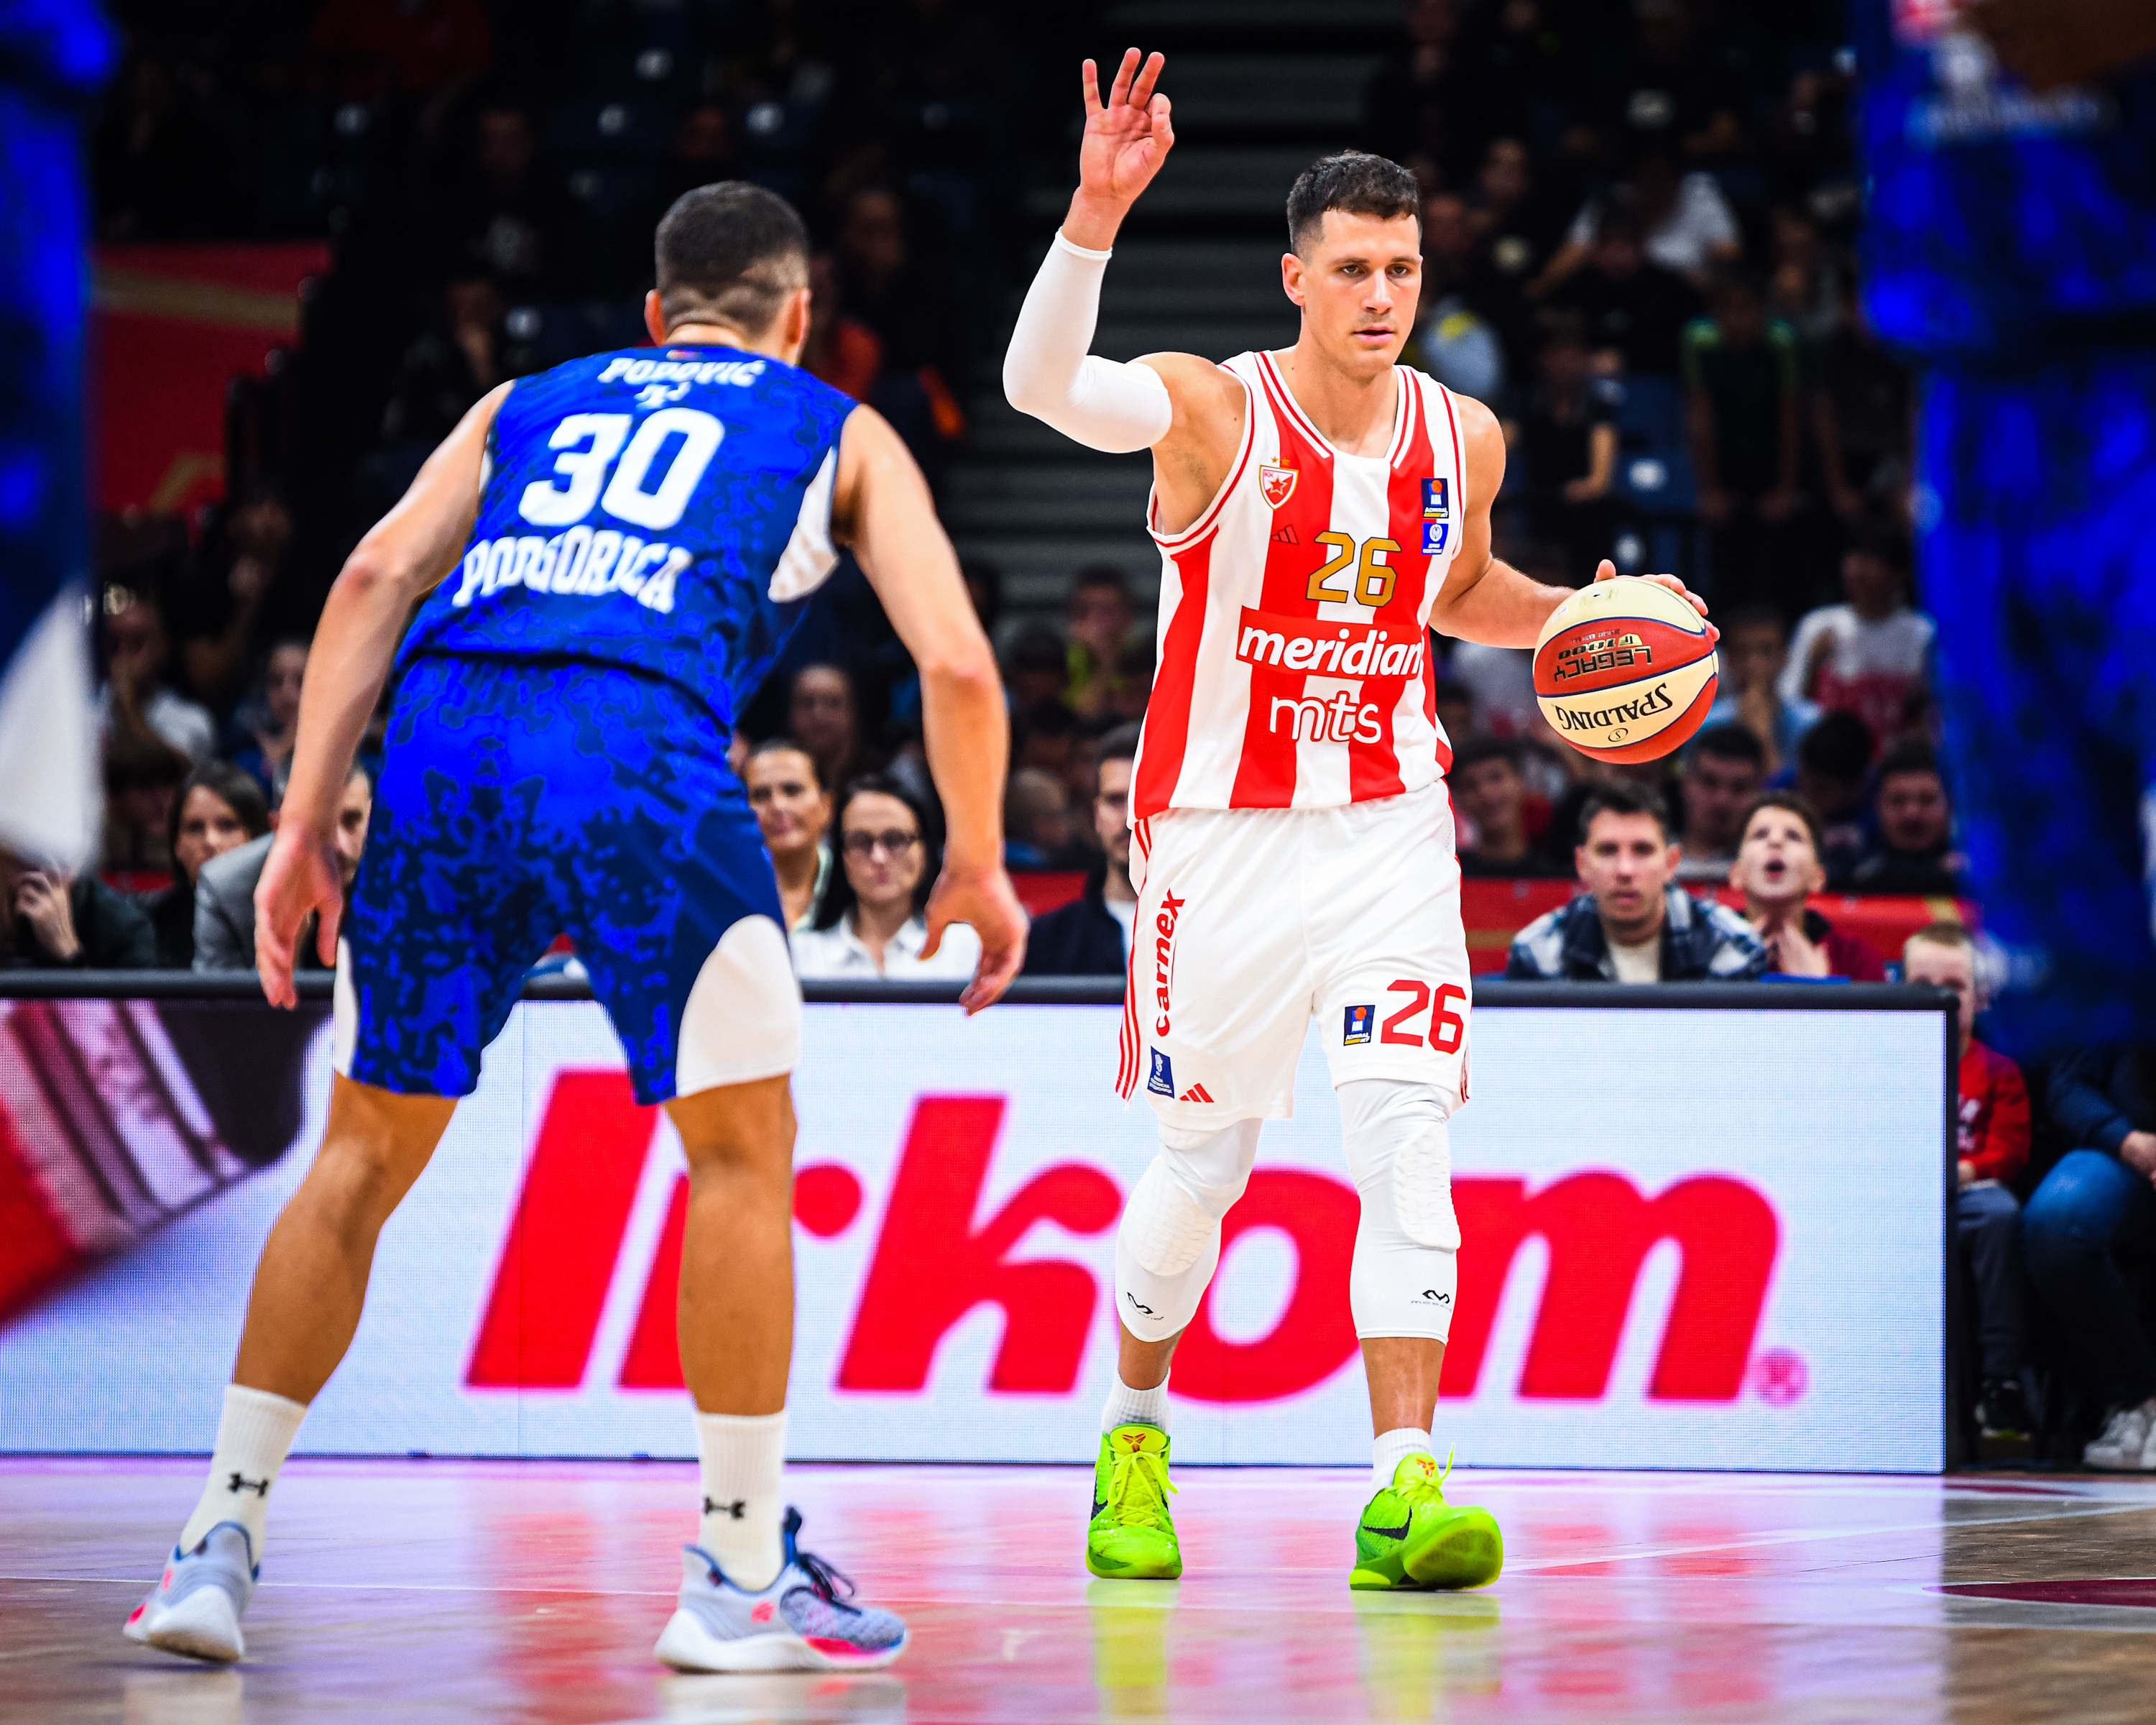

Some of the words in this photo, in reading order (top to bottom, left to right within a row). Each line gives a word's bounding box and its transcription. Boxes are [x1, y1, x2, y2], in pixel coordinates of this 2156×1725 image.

[518, 407, 724, 530] 30
[451, 525, 692, 614] PODGORICA
[1305, 530, 1402, 607] 26
[1238, 626, 1422, 676] meridian
[1554, 646, 1652, 683] LEGACY
[1269, 693, 1381, 744] mts
[1554, 682, 1673, 730] SPALDING
[1156, 888, 1186, 1038] carnex
[1380, 979, 1467, 1055] 26
